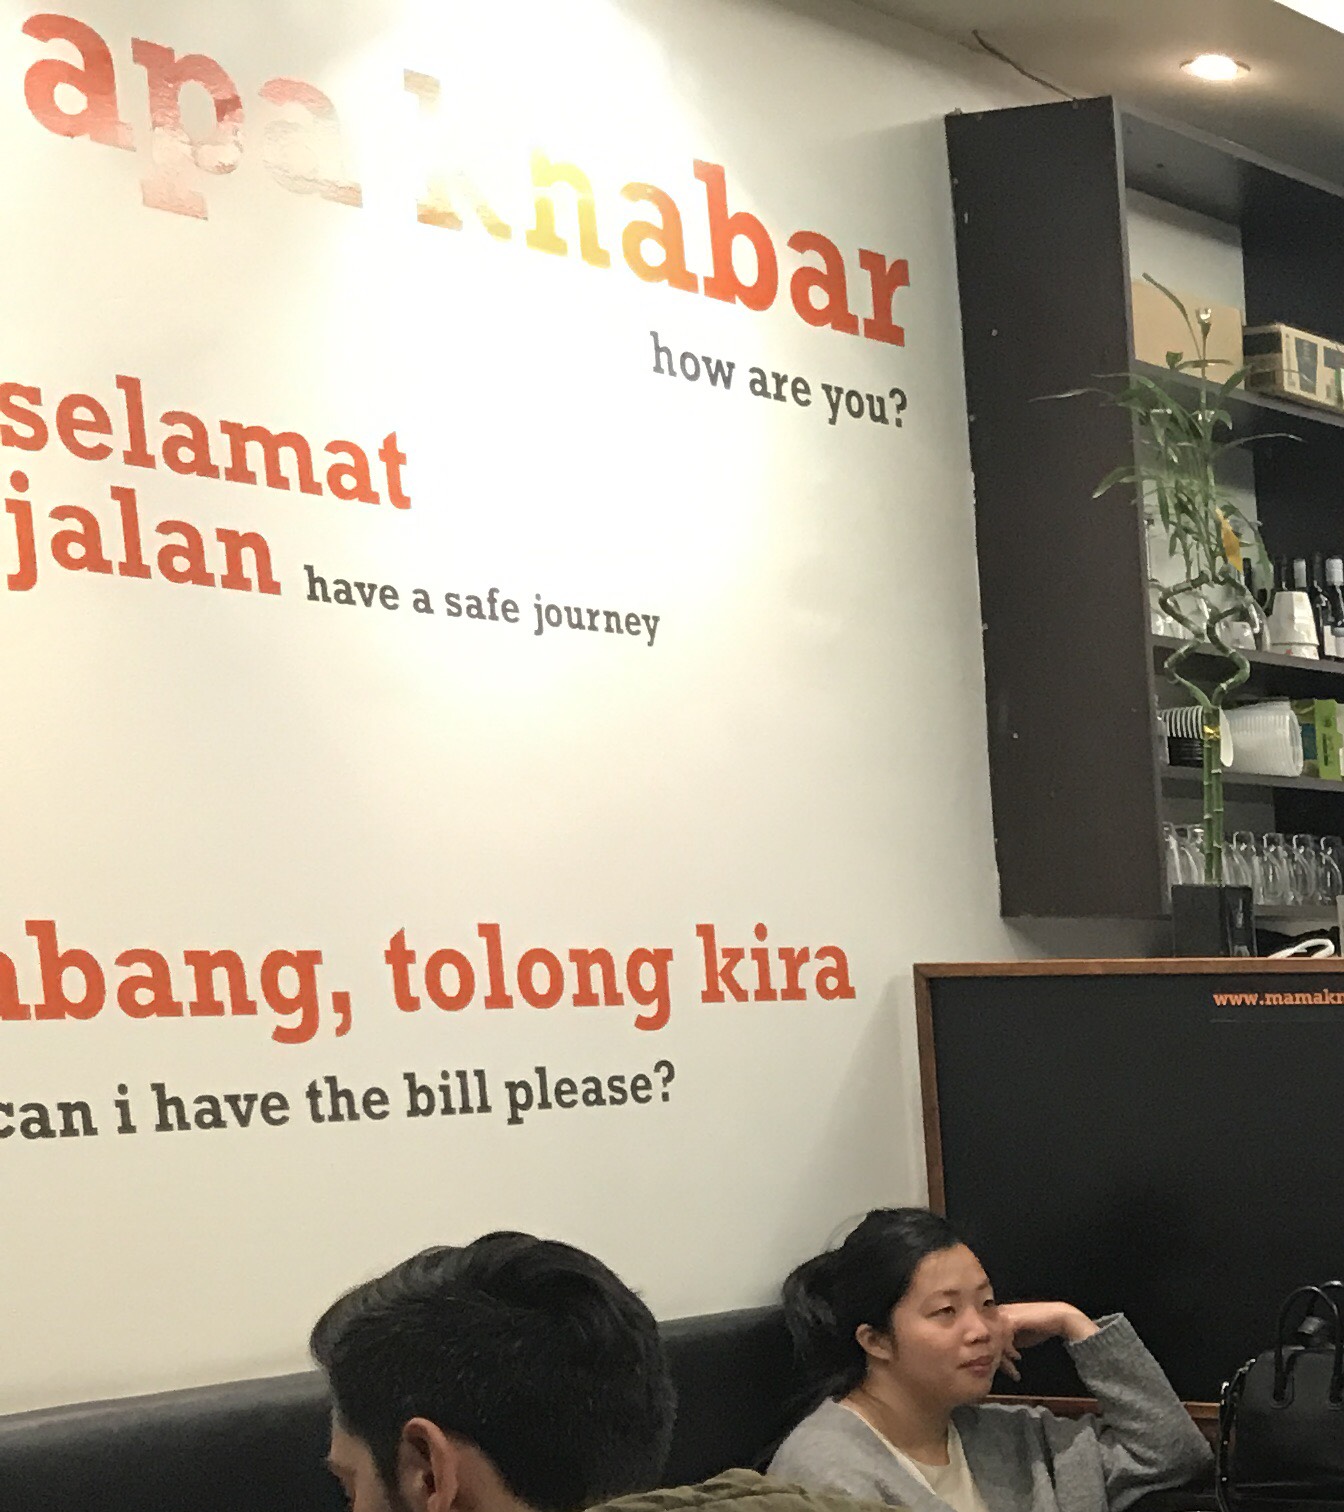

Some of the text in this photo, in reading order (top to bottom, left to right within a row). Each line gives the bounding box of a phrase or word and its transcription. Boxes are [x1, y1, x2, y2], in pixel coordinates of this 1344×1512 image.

[22, 12, 364, 220] apa
[0, 373, 412, 510] selamat
[651, 332, 909, 428] how are you?
[4, 470, 661, 647] jalan have a safe journey
[385, 923, 674, 1032] tolong
[696, 921, 857, 1004] kira
[0, 1060, 677, 1141] can i have the bill please?
